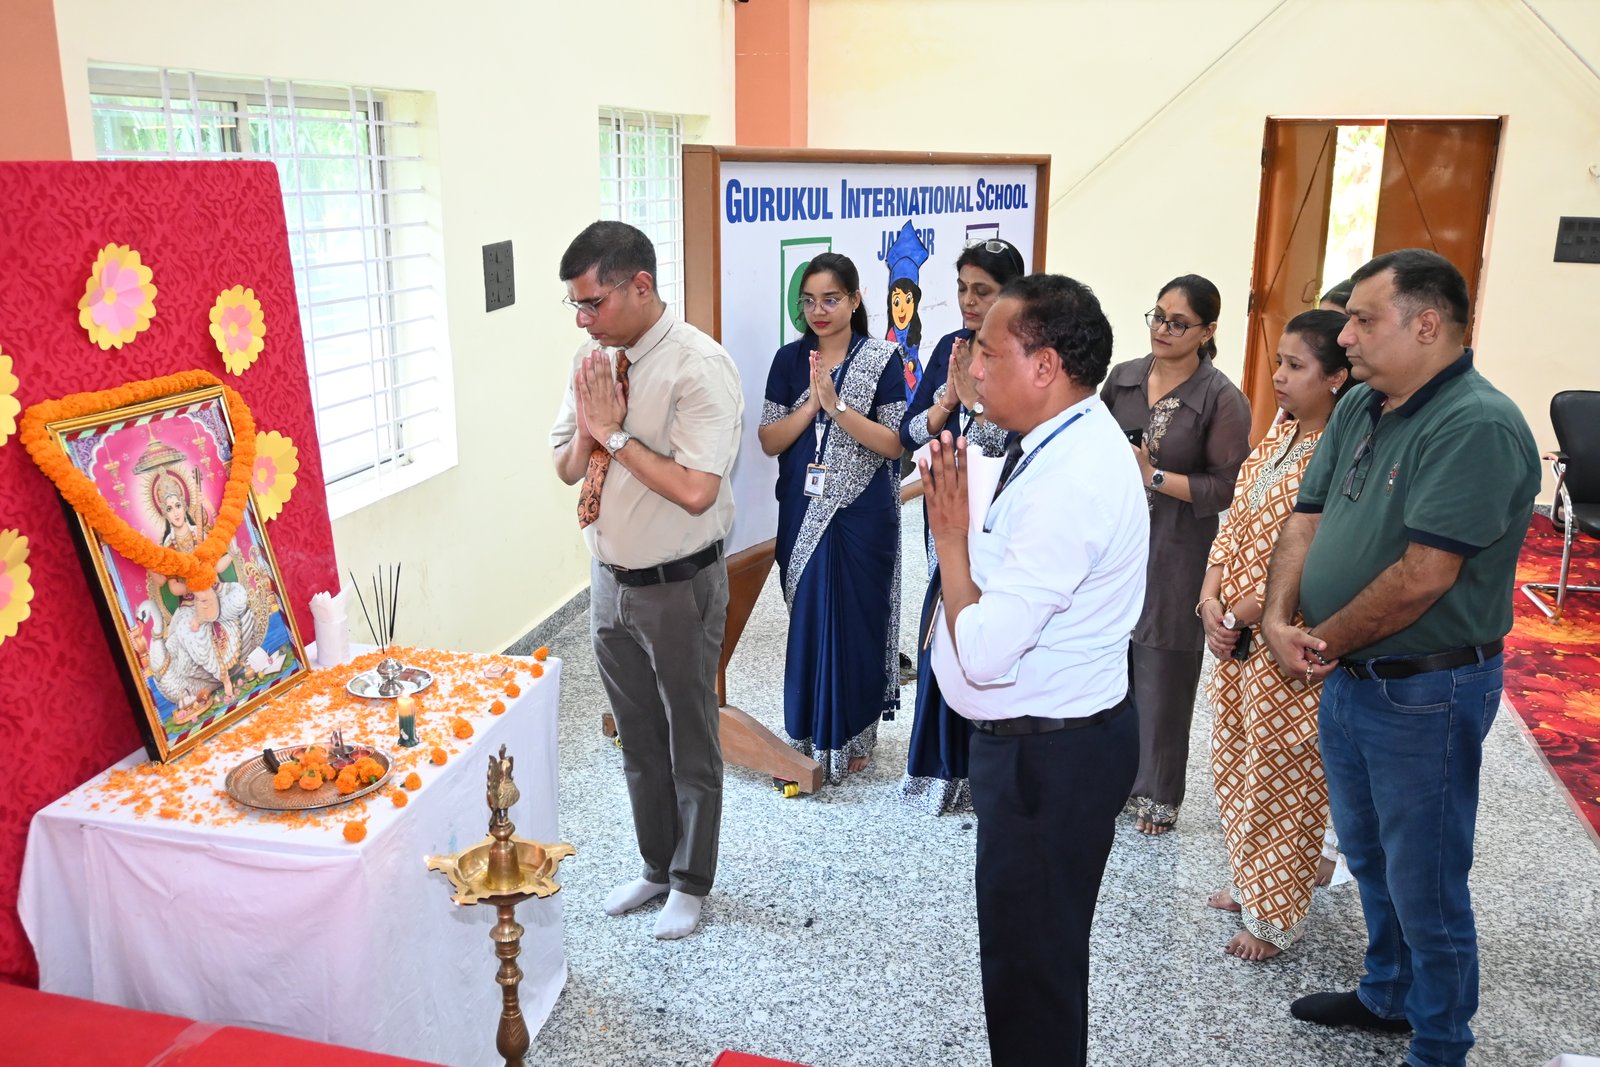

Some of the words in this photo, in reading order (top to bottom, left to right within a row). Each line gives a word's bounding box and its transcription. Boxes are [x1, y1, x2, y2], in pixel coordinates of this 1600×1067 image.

[725, 178, 833, 223] GURUKUL
[841, 179, 974, 219] INTERNATIONAL
[976, 178, 1028, 210] SCHOOL
